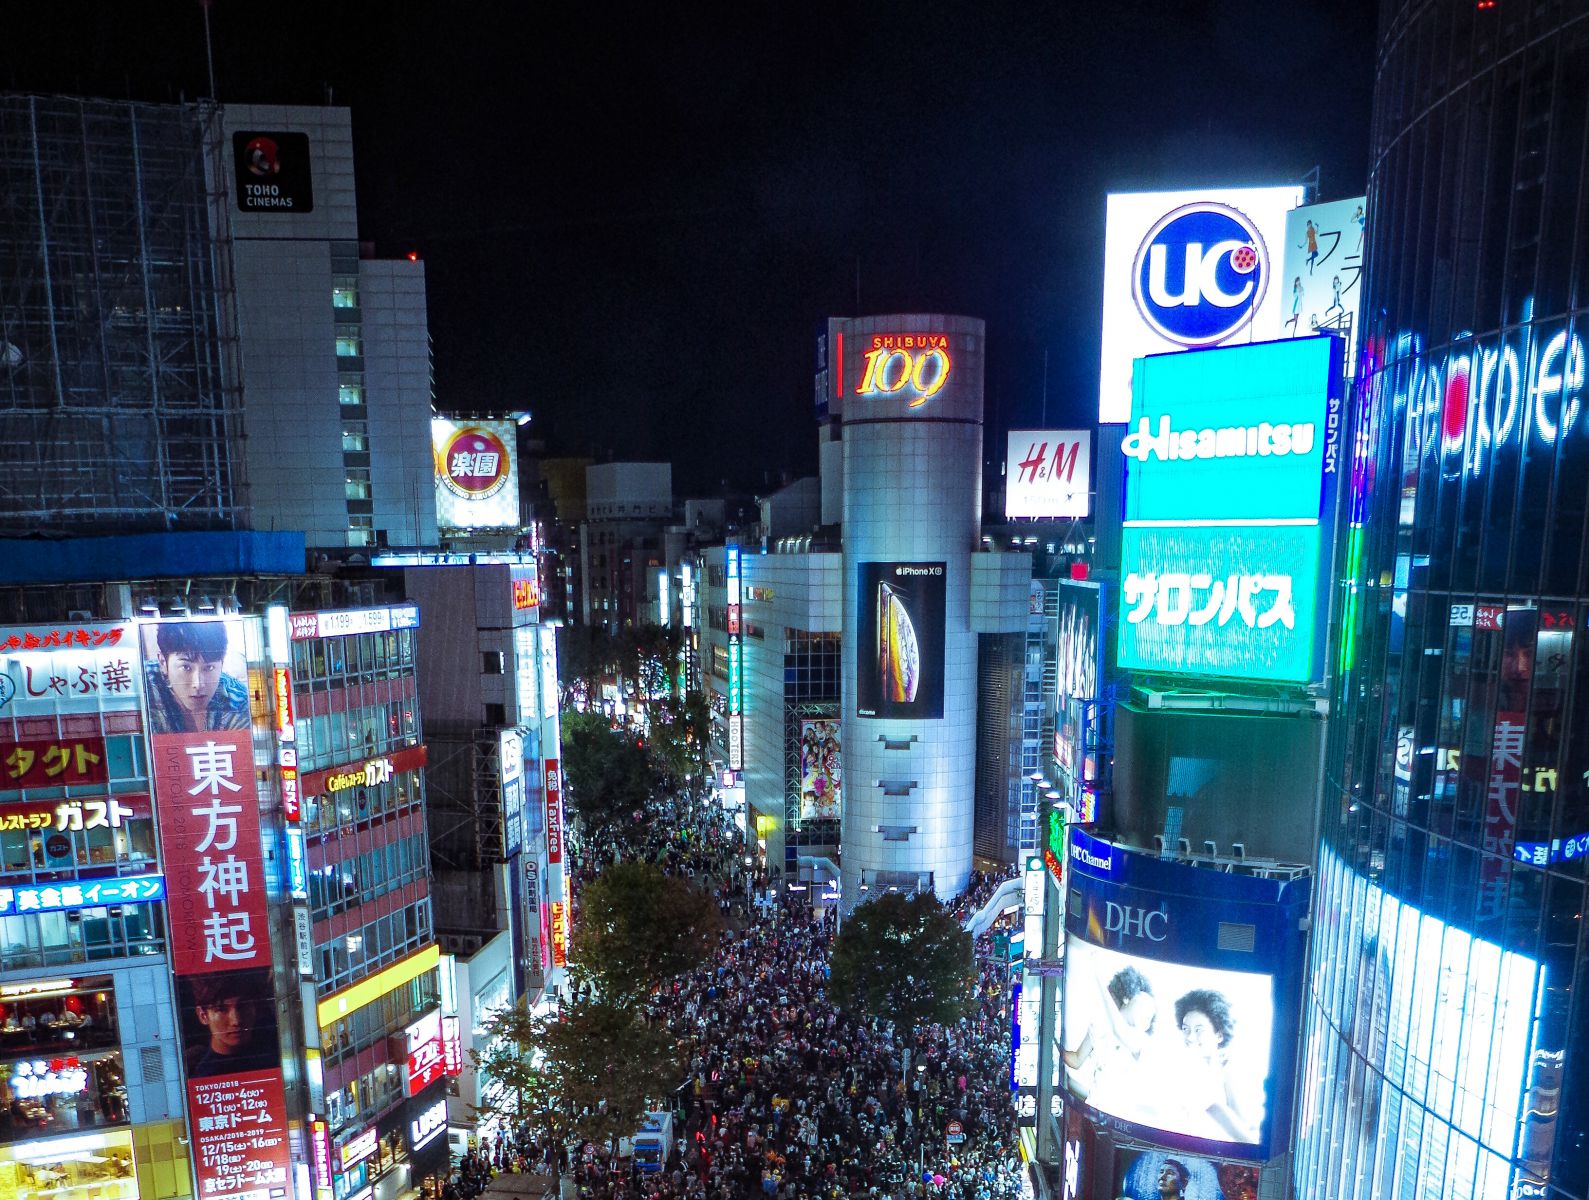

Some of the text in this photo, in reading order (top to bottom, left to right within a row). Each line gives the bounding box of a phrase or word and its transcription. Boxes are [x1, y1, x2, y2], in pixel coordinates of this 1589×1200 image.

[245, 184, 279, 196] TOHO
[247, 197, 293, 207] CINEMAS
[873, 336, 948, 348] SHIBUYA
[856, 347, 951, 408] 109
[1121, 414, 1315, 462] Hisamitsu
[1325, 398, 1341, 474] サロンパス
[450, 451, 500, 477] 楽園
[1018, 441, 1080, 485] H&M
[903, 567, 928, 576] iPhone
[1123, 572, 1296, 630] サロンパス
[25, 658, 132, 697] しゃぶ葉
[166, 746, 182, 772] LIVE
[730, 720, 740, 766] HOOTERS
[365, 759, 394, 787] ガスト
[168, 773, 185, 812] TOUR
[285, 780, 298, 815] ガスト
[55, 800, 134, 832] ガスト
[548, 800, 560, 853] TaxFree
[185, 741, 258, 963] 東方神起
[1081, 850, 1112, 871] Channel
[18, 881, 160, 911] 英会話イーオン
[1104, 901, 1168, 942] DHC
[297, 911, 310, 968] 渋谷駅前ビル
[195, 1080, 240, 1092] TOKYO/2018
[198, 1110, 273, 1132] 東京ドーム
[200, 1128, 265, 1143] OSAKA/2018-2019
[412, 1099, 448, 1143] LUSH
[1113, 1120, 1133, 1135] DHC
[204, 1167, 287, 1193] 京セラドーム大阪
